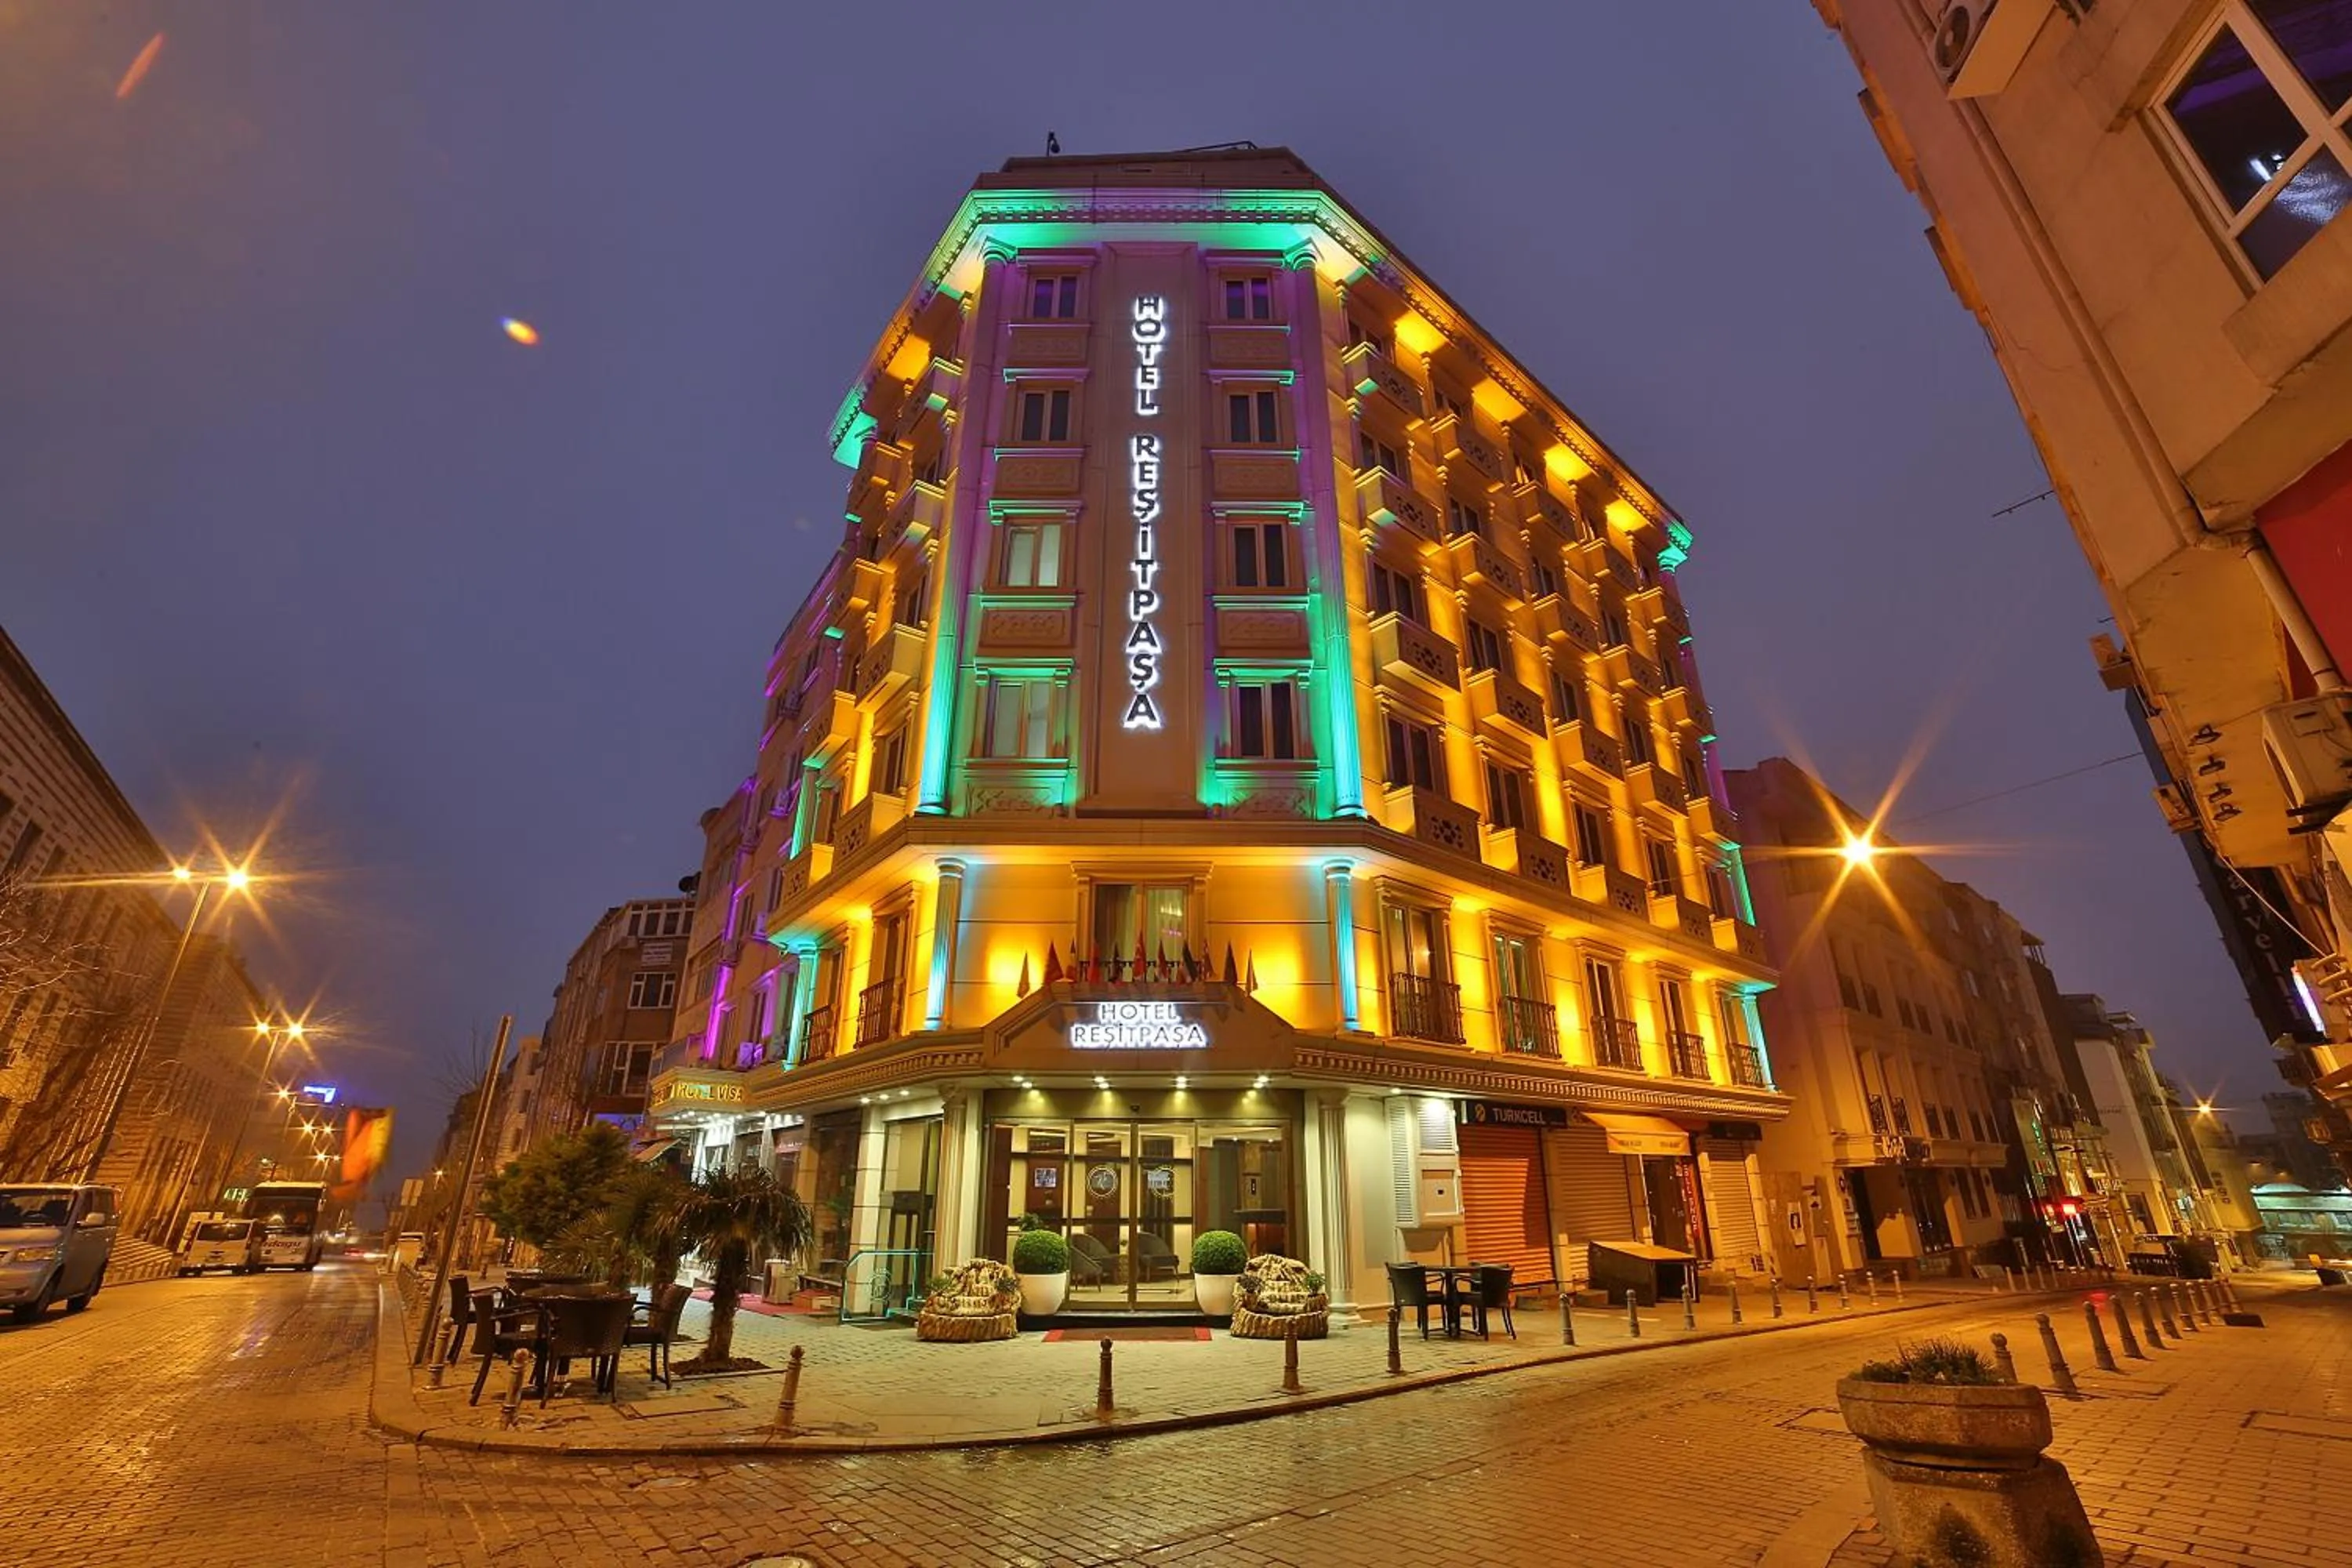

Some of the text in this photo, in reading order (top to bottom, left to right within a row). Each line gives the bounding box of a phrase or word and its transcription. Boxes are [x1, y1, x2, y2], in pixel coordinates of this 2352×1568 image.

[1123, 296, 1166, 728] HOTEL REŞİTPAŞA
[1099, 1002, 1181, 1021] HOTEL
[1073, 1023, 1205, 1051] REŞİTPAŞA
[1492, 1107, 1546, 1125] TURKCELL
